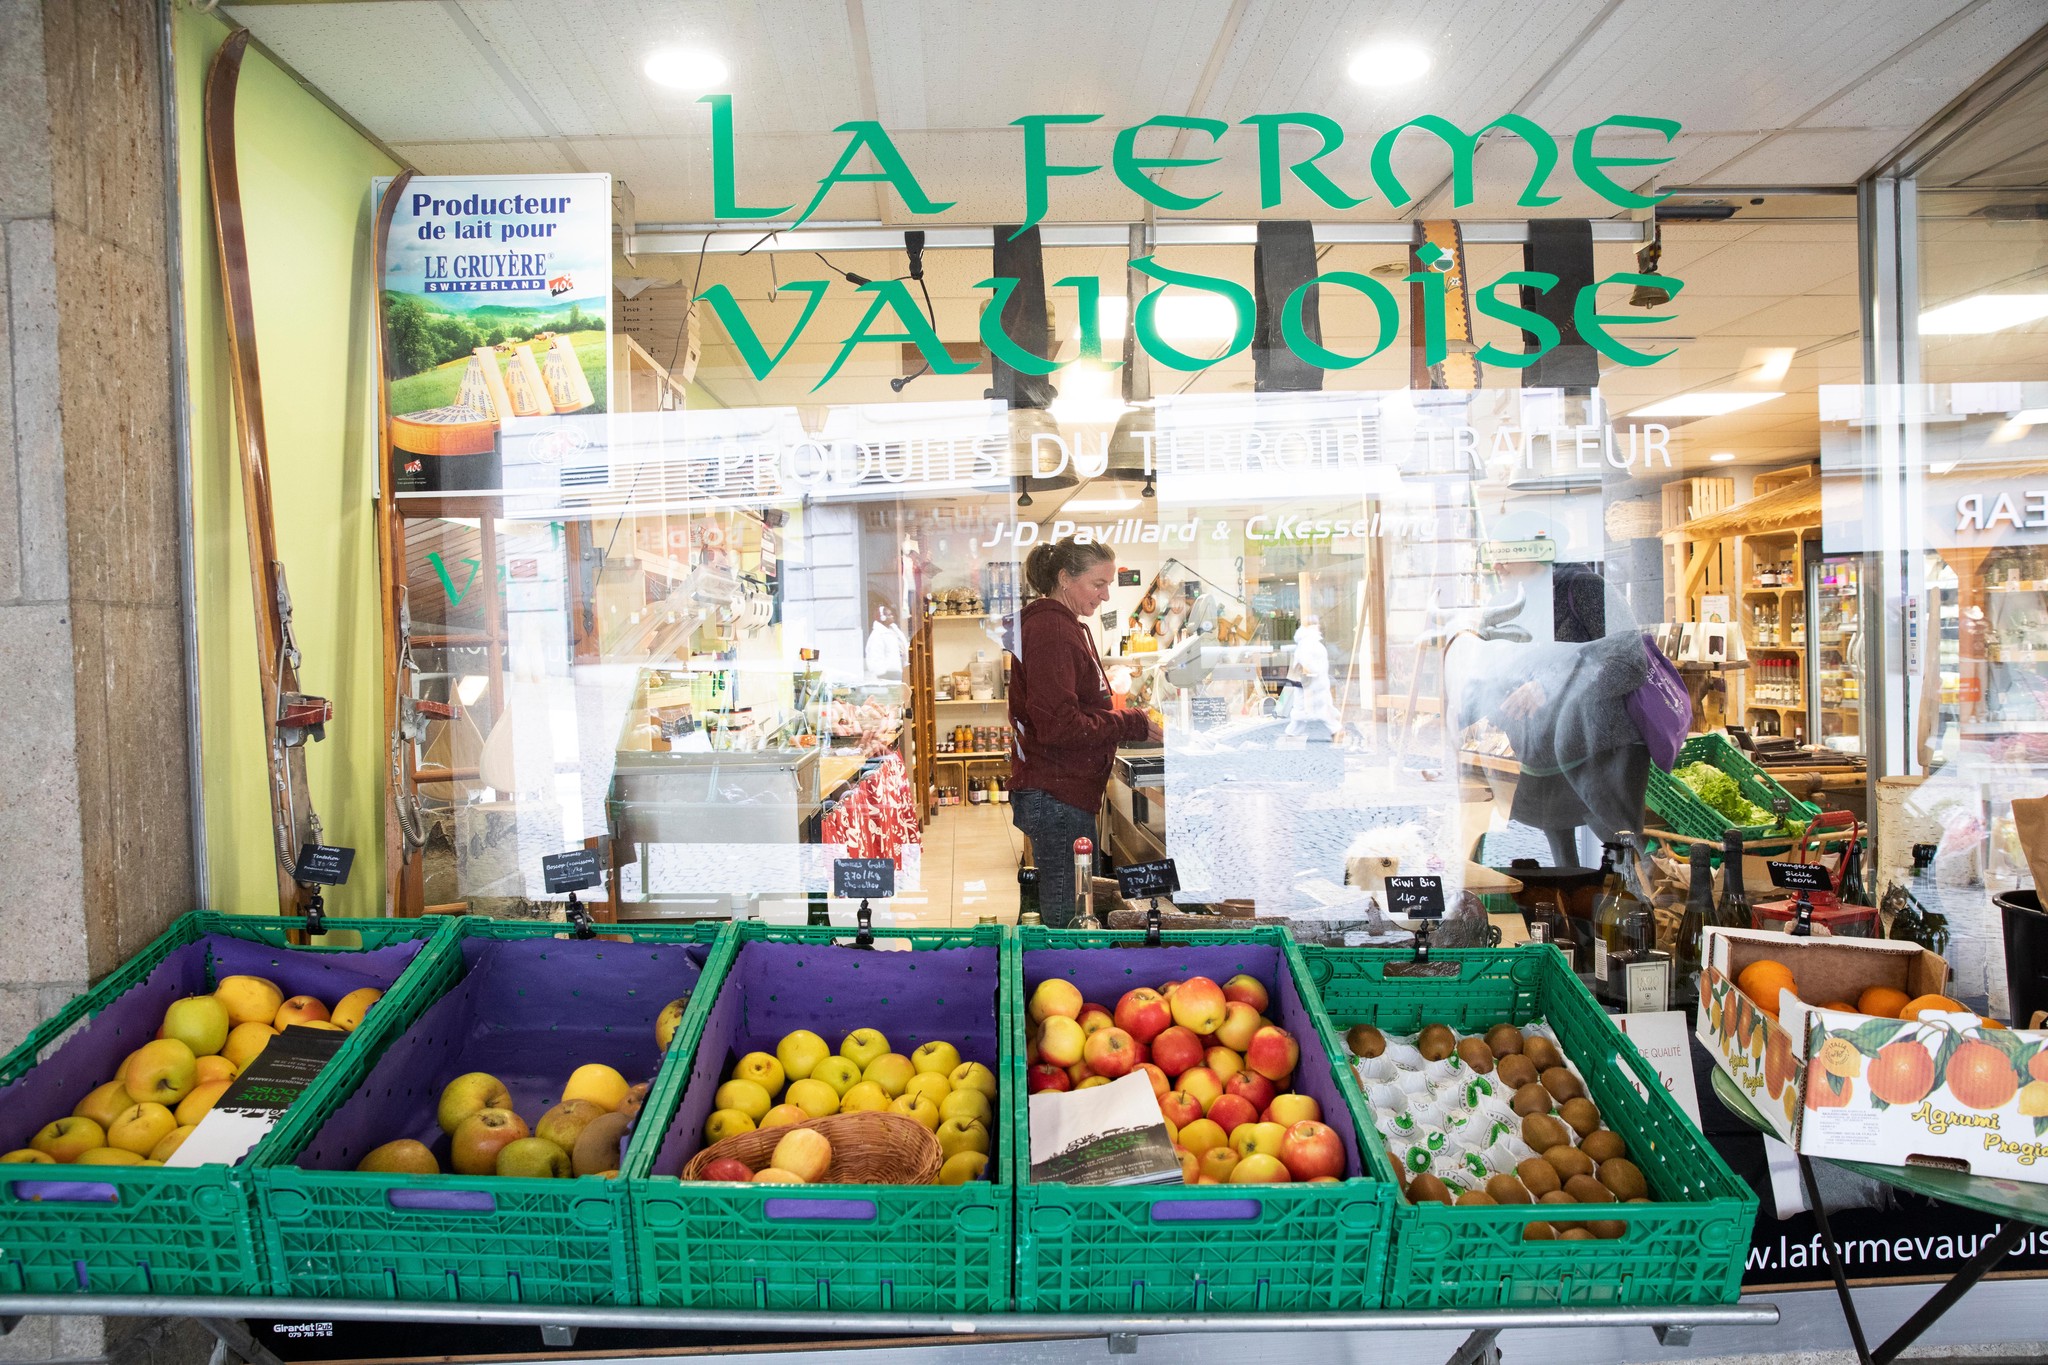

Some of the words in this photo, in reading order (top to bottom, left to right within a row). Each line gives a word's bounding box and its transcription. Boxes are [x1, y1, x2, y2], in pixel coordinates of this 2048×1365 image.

[695, 93, 957, 232] LA
[1007, 111, 1683, 242] FERME
[412, 193, 571, 216] Producteur
[418, 221, 446, 240] de
[454, 221, 492, 239] lait
[501, 221, 557, 242] pour
[424, 255, 448, 279] LE
[430, 281, 541, 290] SWITZERLAND
[693, 241, 1685, 394] VAUDOISE
[718, 434, 999, 486] PRODUITS
[1031, 431, 1108, 479] DU
[1129, 426, 1365, 476] TERROIR
[1415, 422, 1672, 471] TRAITEUR
[1212, 520, 1231, 541] &
[867, 860, 887, 869] Gold
[1772, 861, 1808, 870] Oranges
[1785, 870, 1813, 878] Sicile
[1391, 877, 1414, 888] Kiwi
[1419, 877, 1437, 888] Bio
[1650, 1045, 1682, 1058] QUALITÉ
[1911, 1101, 2001, 1134] Agrumi
[273, 1323, 315, 1333] Girardet
[316, 1322, 333, 1331] Pub
